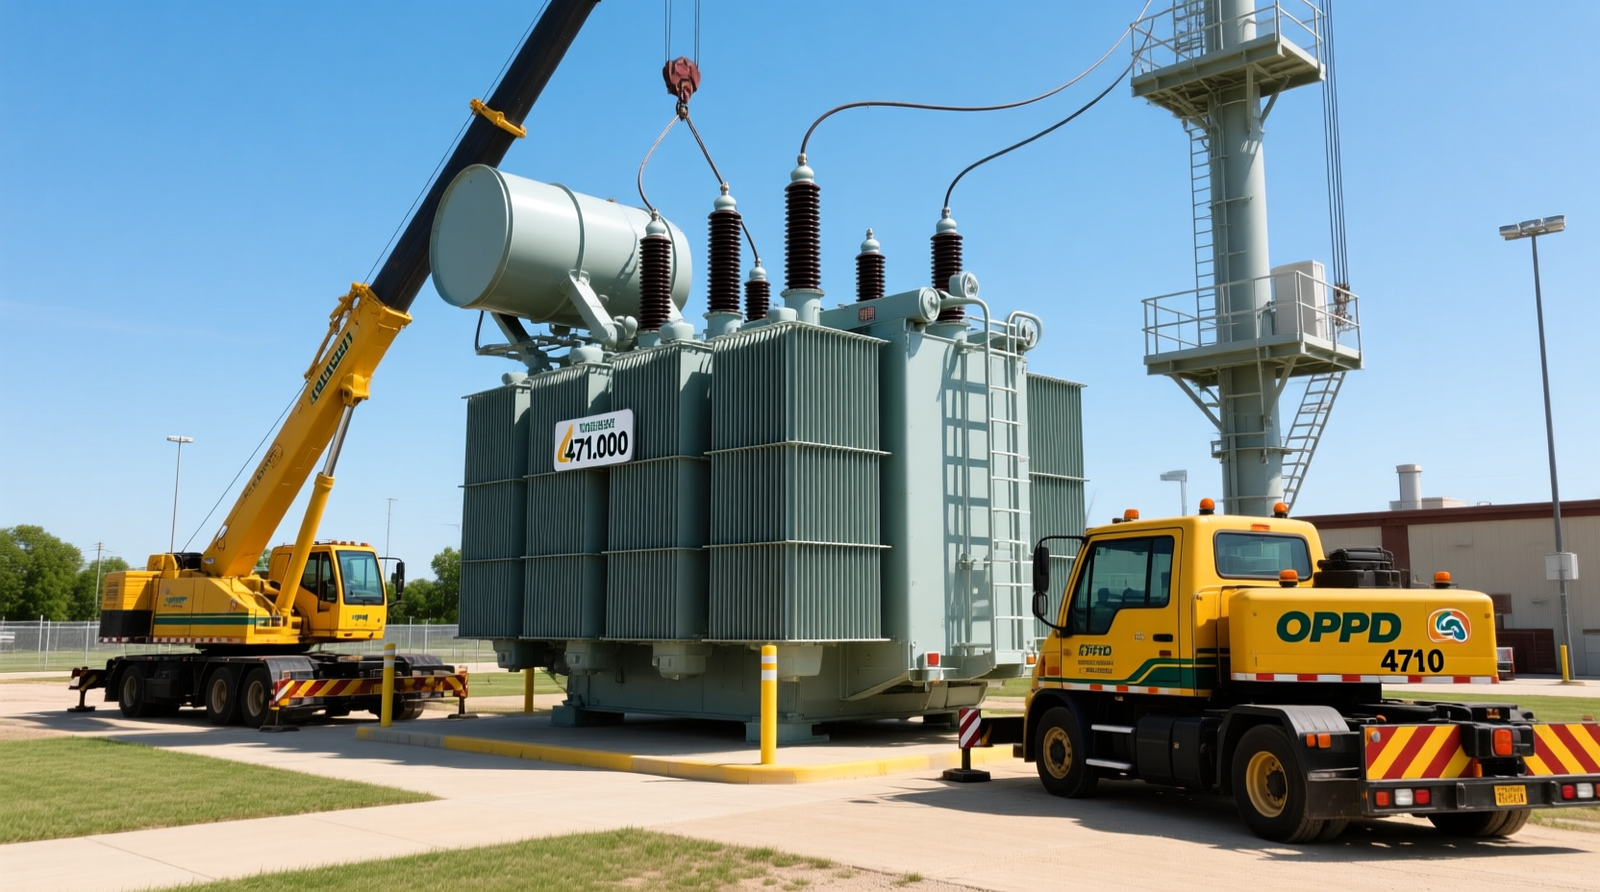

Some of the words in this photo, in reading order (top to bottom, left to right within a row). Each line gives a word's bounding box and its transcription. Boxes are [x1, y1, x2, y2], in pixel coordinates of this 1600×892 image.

[564, 430, 629, 463] 471.000
[1276, 610, 1402, 643] OPPD
[1380, 649, 1445, 673] 4710
